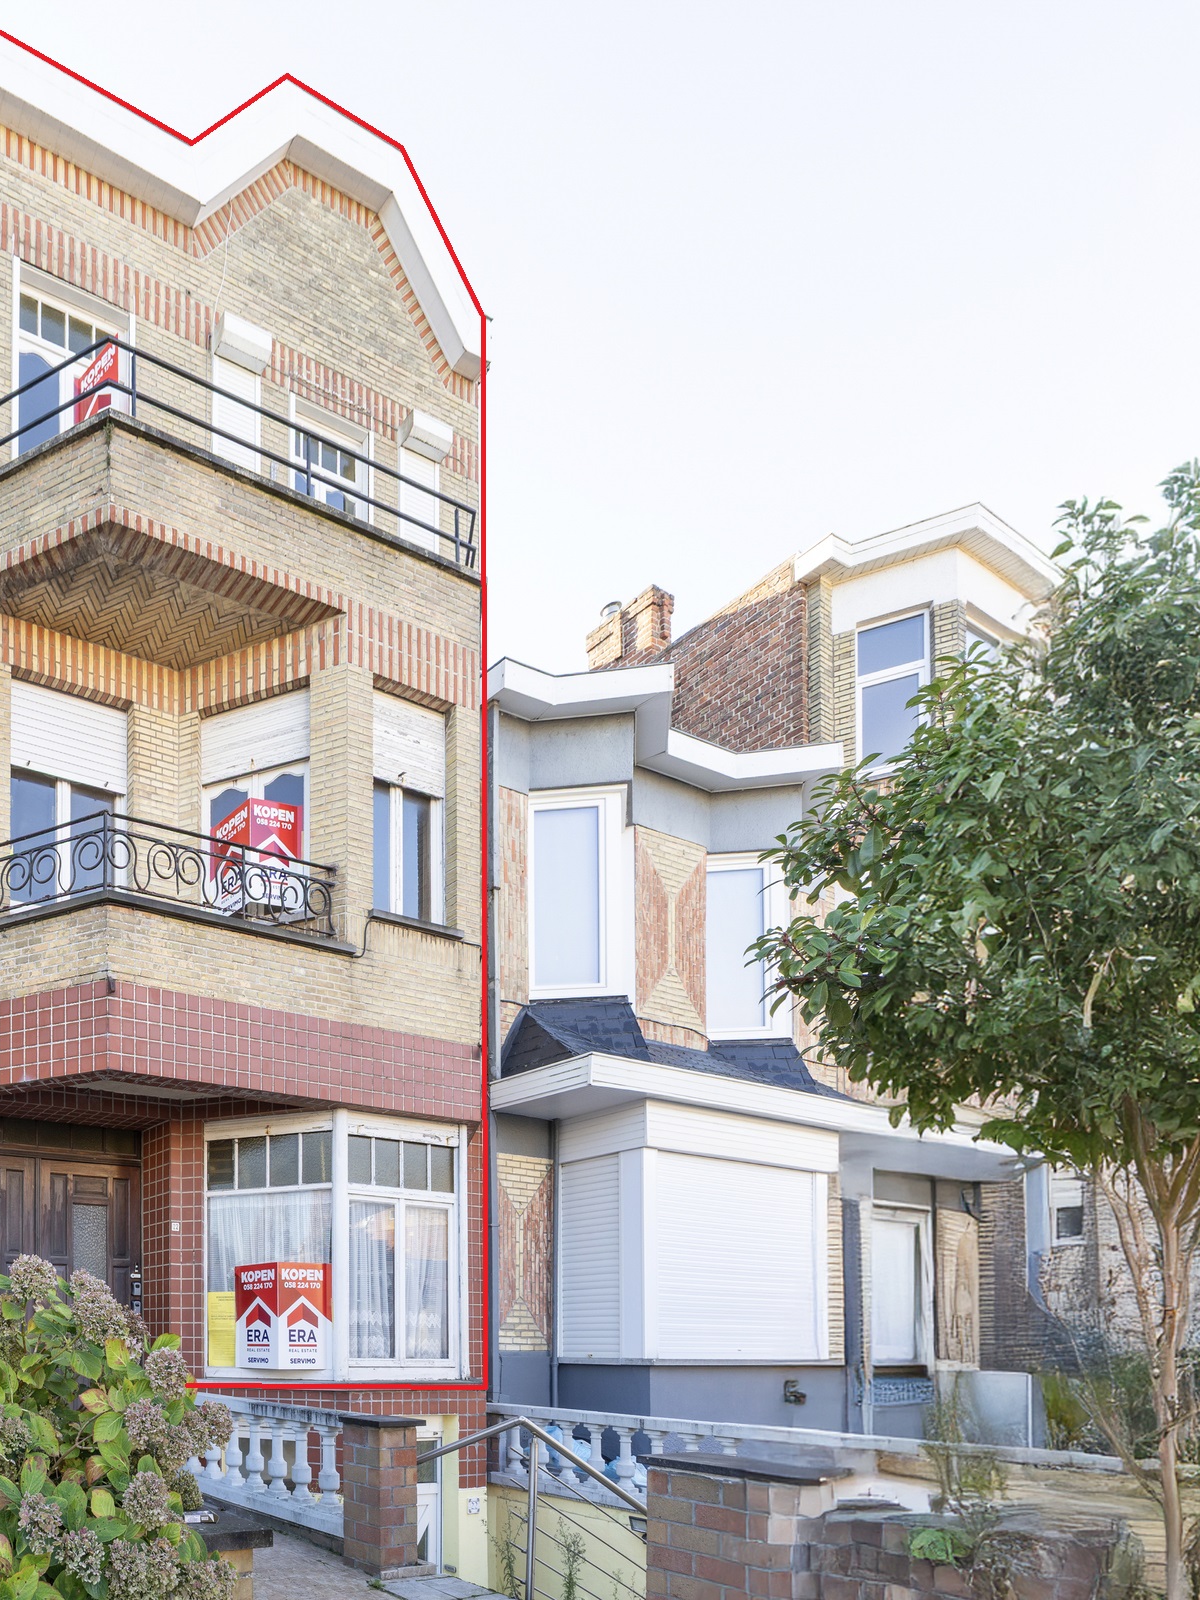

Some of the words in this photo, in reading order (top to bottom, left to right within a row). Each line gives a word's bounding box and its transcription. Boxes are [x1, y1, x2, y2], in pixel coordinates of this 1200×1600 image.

[80, 343, 116, 394] KOPEN
[253, 804, 295, 823] KOPEN
[216, 806, 248, 839] KOPEN
[256, 818, 268, 826] 058
[269, 820, 280, 828] 224
[281, 822, 292, 830] 170
[241, 1268, 275, 1283] KOPEN
[281, 1268, 323, 1281] KOPEN
[247, 1329, 270, 1342] ERA
[288, 1329, 317, 1342] ERA
